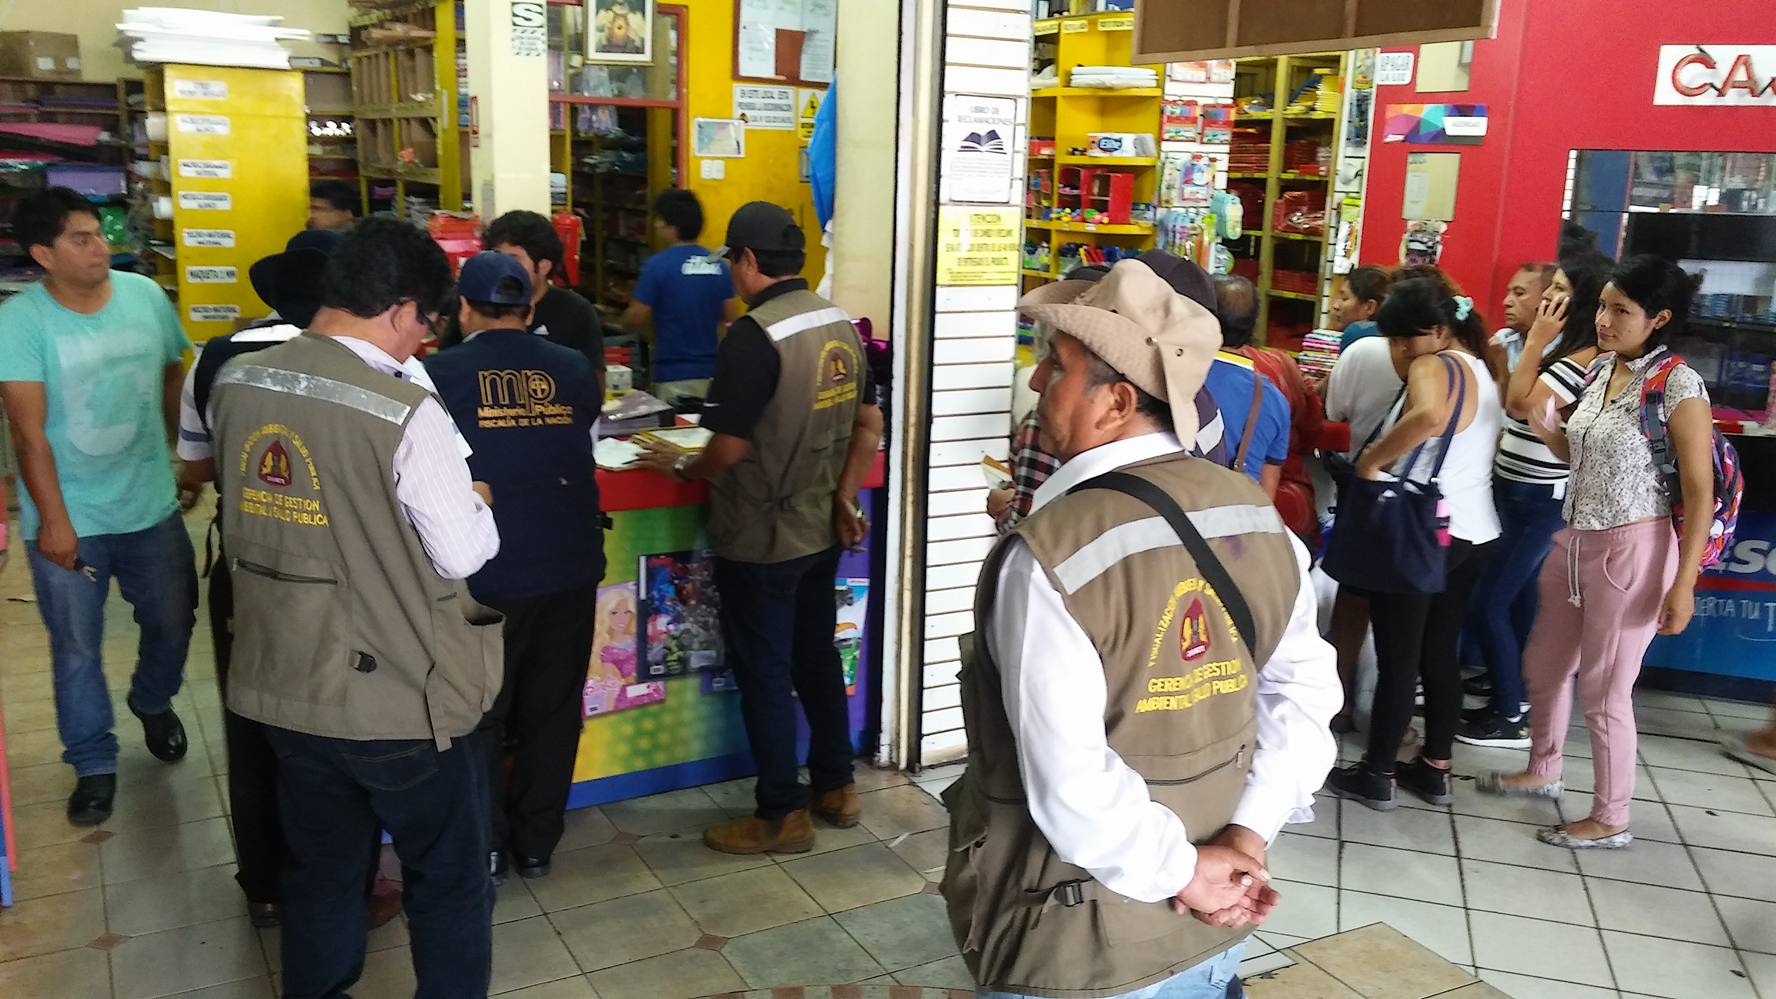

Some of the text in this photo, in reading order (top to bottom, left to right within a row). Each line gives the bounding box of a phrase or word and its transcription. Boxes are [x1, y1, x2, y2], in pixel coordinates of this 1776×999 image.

[1672, 53, 1776, 97] CA
[970, 105, 1000, 115] LIBRO DE
[957, 115, 1013, 126] RECLAMACIONES
[477, 406, 527, 418] Ministerio
[274, 493, 283, 506] DE
[284, 495, 320, 511] GESTION
[292, 511, 329, 528] PUBLICA
[1739, 600, 1760, 620] TU
